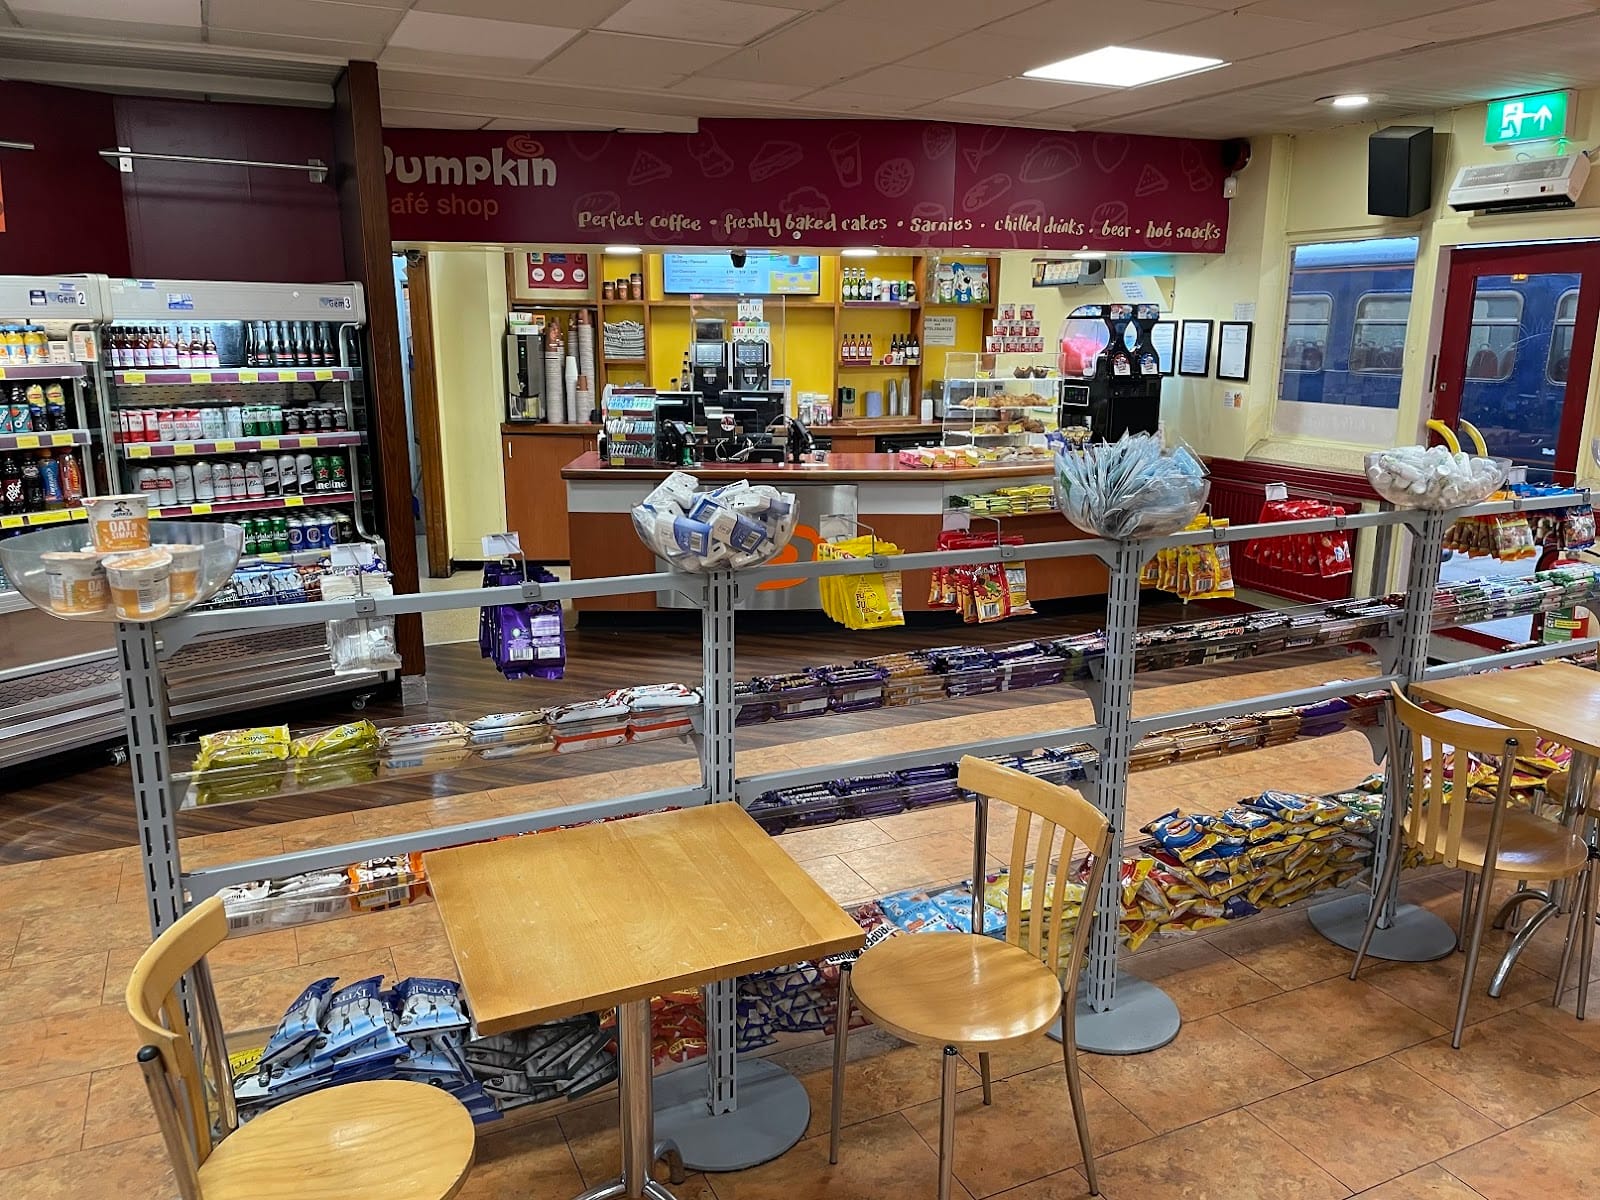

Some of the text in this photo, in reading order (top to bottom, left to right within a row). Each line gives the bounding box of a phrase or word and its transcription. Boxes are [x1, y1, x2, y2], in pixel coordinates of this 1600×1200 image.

[391, 191, 499, 221] afé shop
[577, 209, 644, 231] Perfect
[649, 213, 702, 232] coffee
[724, 212, 782, 238] freshly
[785, 212, 837, 233] baked
[841, 213, 888, 233] cakes
[994, 215, 1041, 234] chilled
[1043, 216, 1085, 236] drinks
[1101, 218, 1131, 238] beer
[1146, 219, 1174, 239] hot
[1175, 221, 1222, 242] snacks
[57, 294, 77, 305] Gem
[78, 292, 86, 306] 2
[328, 298, 345, 308] Gem
[344, 298, 351, 309] 3
[108, 520, 132, 533] OAT
[111, 529, 138, 540] SIMPLE
[358, 863, 412, 882] revels
[333, 987, 373, 1004] Tyrre
